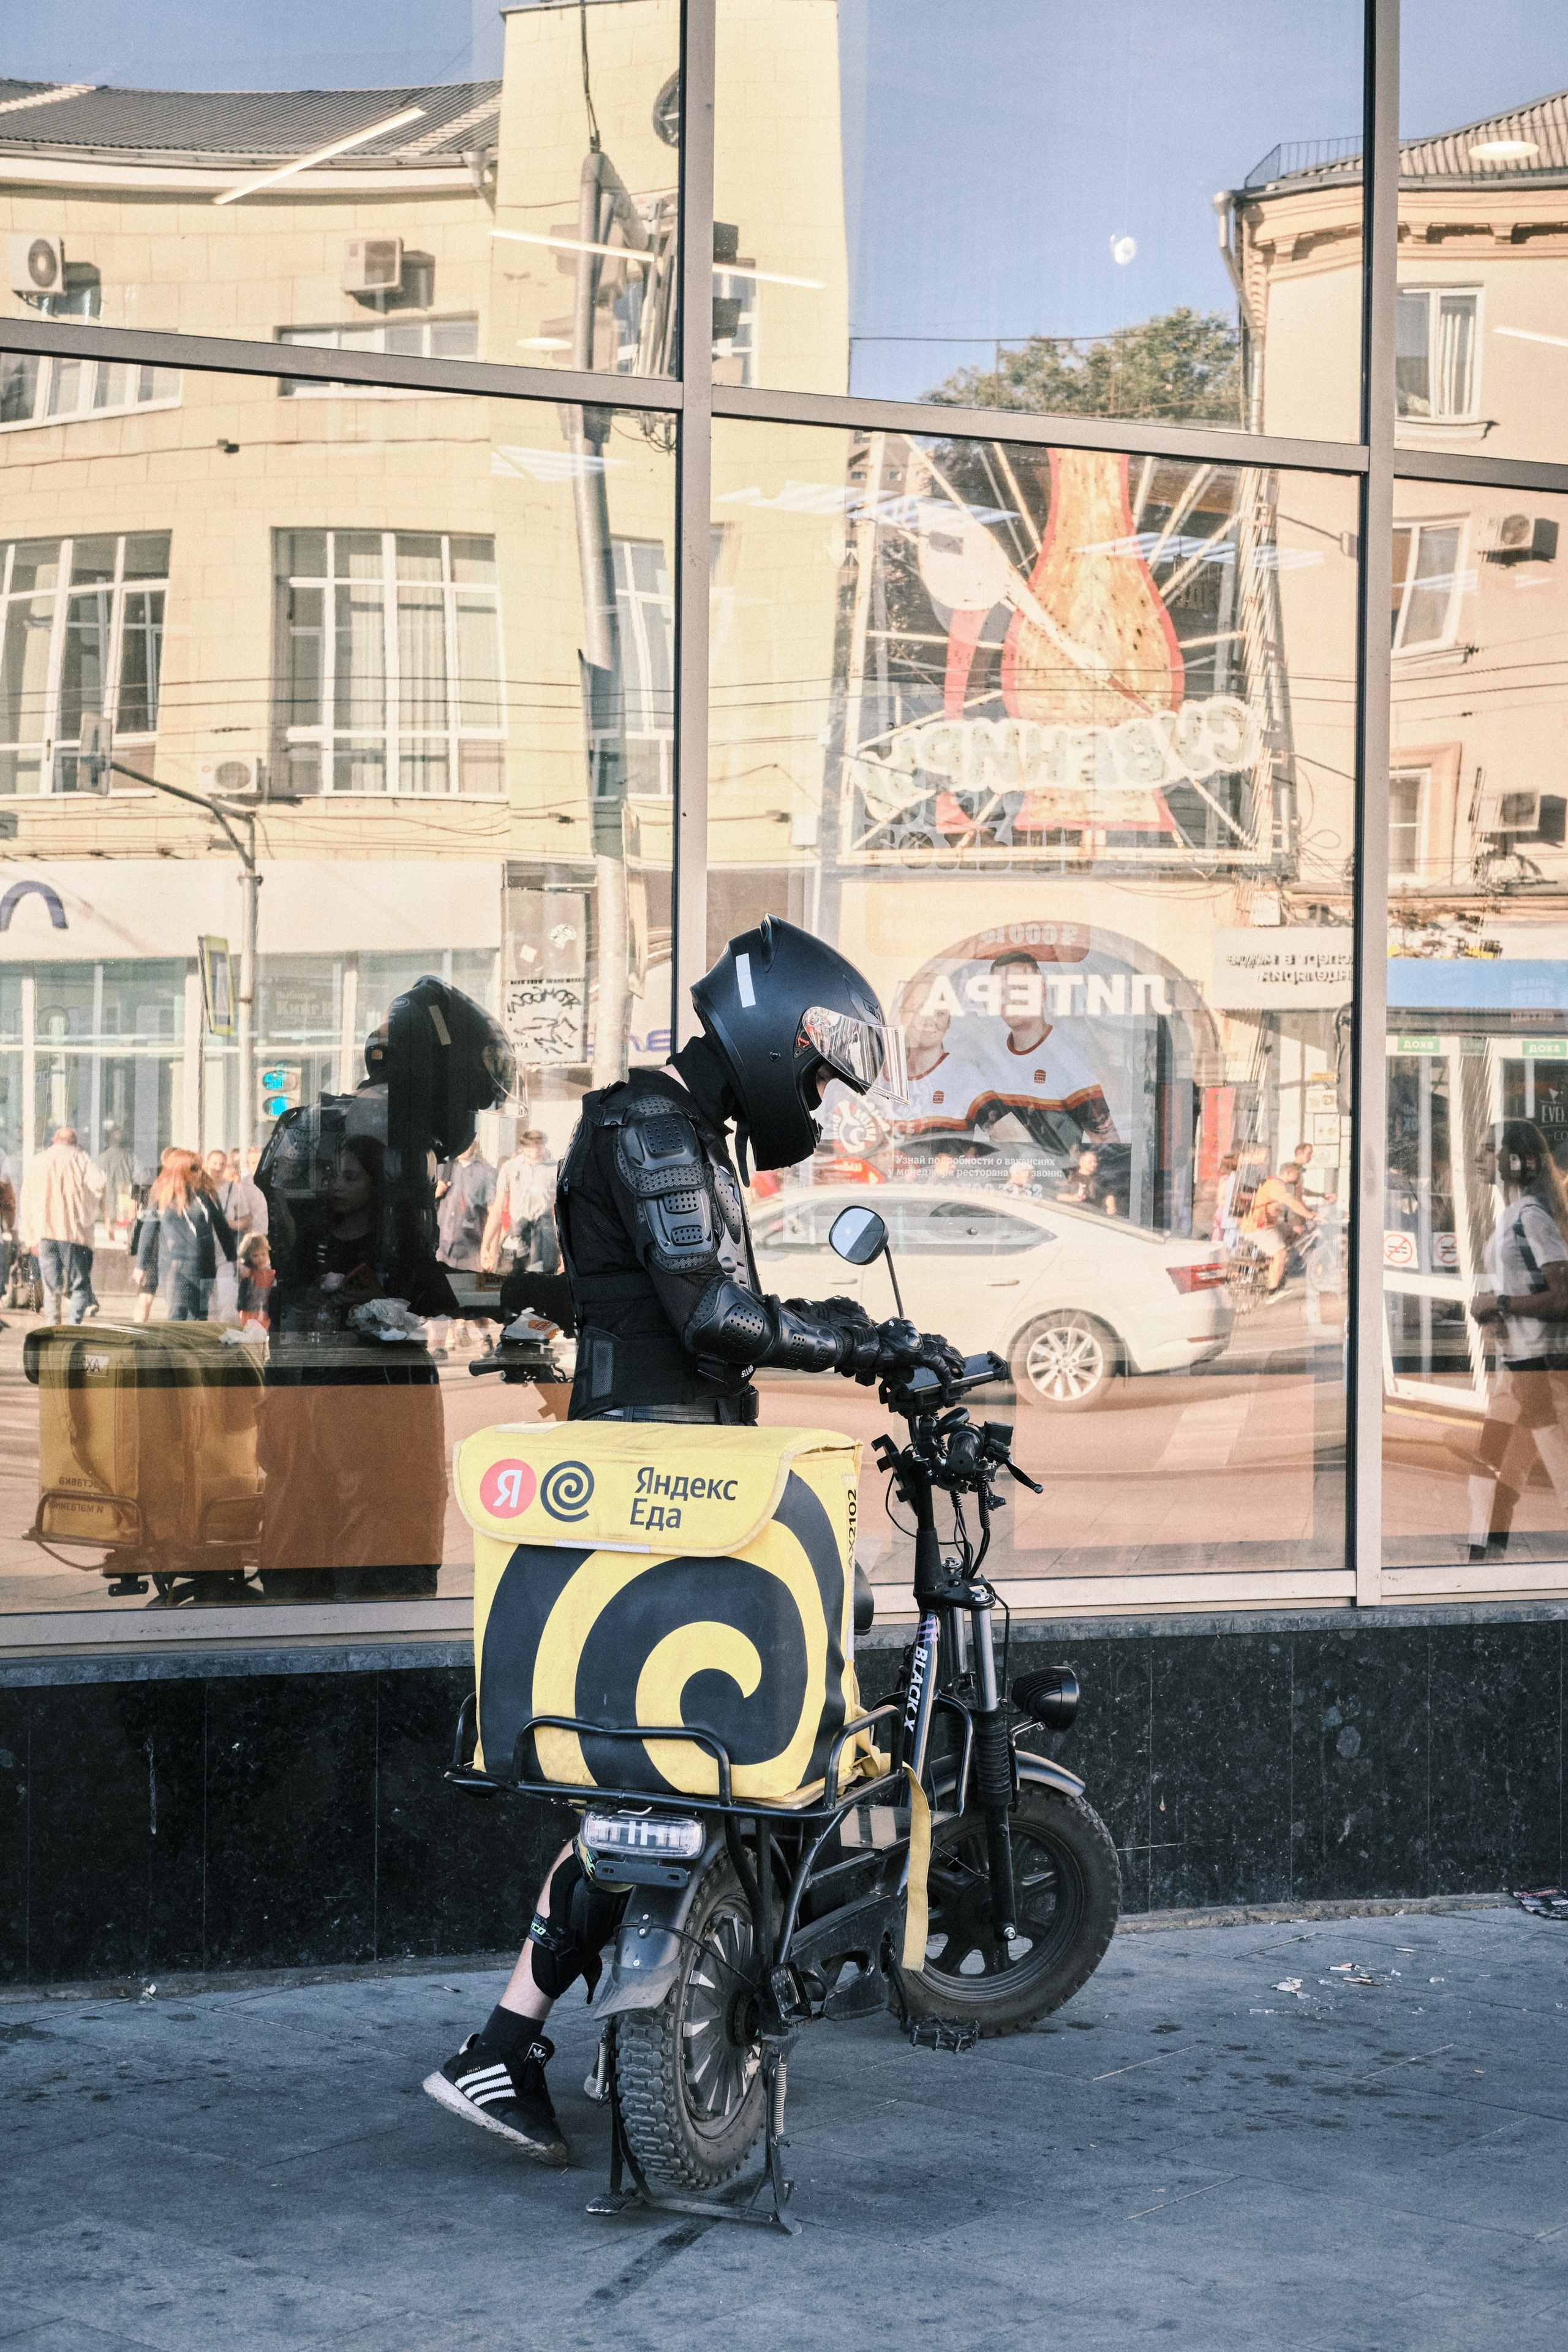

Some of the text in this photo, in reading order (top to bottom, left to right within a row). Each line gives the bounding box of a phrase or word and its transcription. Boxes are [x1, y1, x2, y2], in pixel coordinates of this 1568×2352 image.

[895, 1155, 927, 1165] Узнай
[928, 1155, 992, 1166] поробности
[956, 1169, 1009, 1179] ресторана
[1031, 1169, 1062, 1178] звони:
[492, 1469, 523, 1507] Я
[635, 1466, 738, 1501] Яндекс
[630, 1498, 682, 1531] Еда
[907, 1645, 928, 1714] BLACK
[467, 2065, 481, 2074] INIKI
